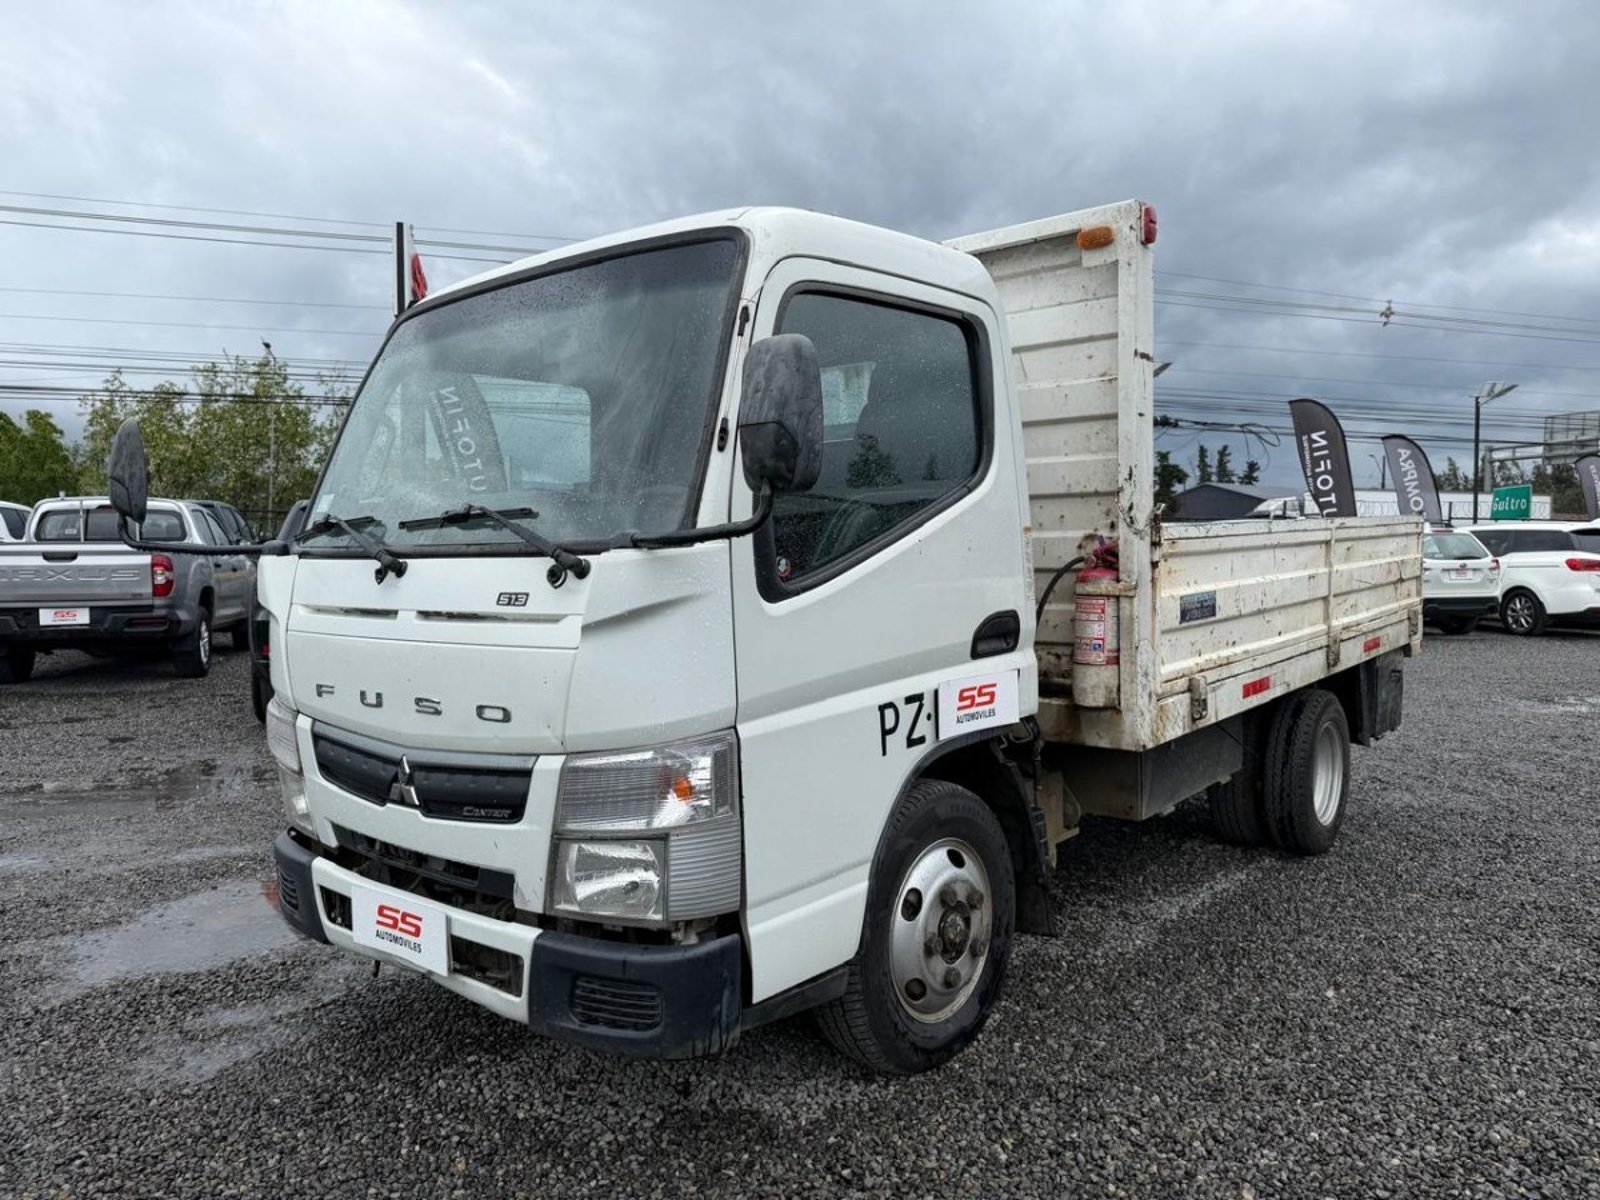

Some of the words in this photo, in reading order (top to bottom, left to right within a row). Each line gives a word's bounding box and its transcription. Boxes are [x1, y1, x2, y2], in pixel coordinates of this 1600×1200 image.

[315, 683, 512, 724] FUSO
[956, 683, 998, 711] SS
[956, 708, 997, 725] AUTOMOVILES
[376, 904, 423, 938] SS
[375, 929, 422, 953] AUTOMOVILES
